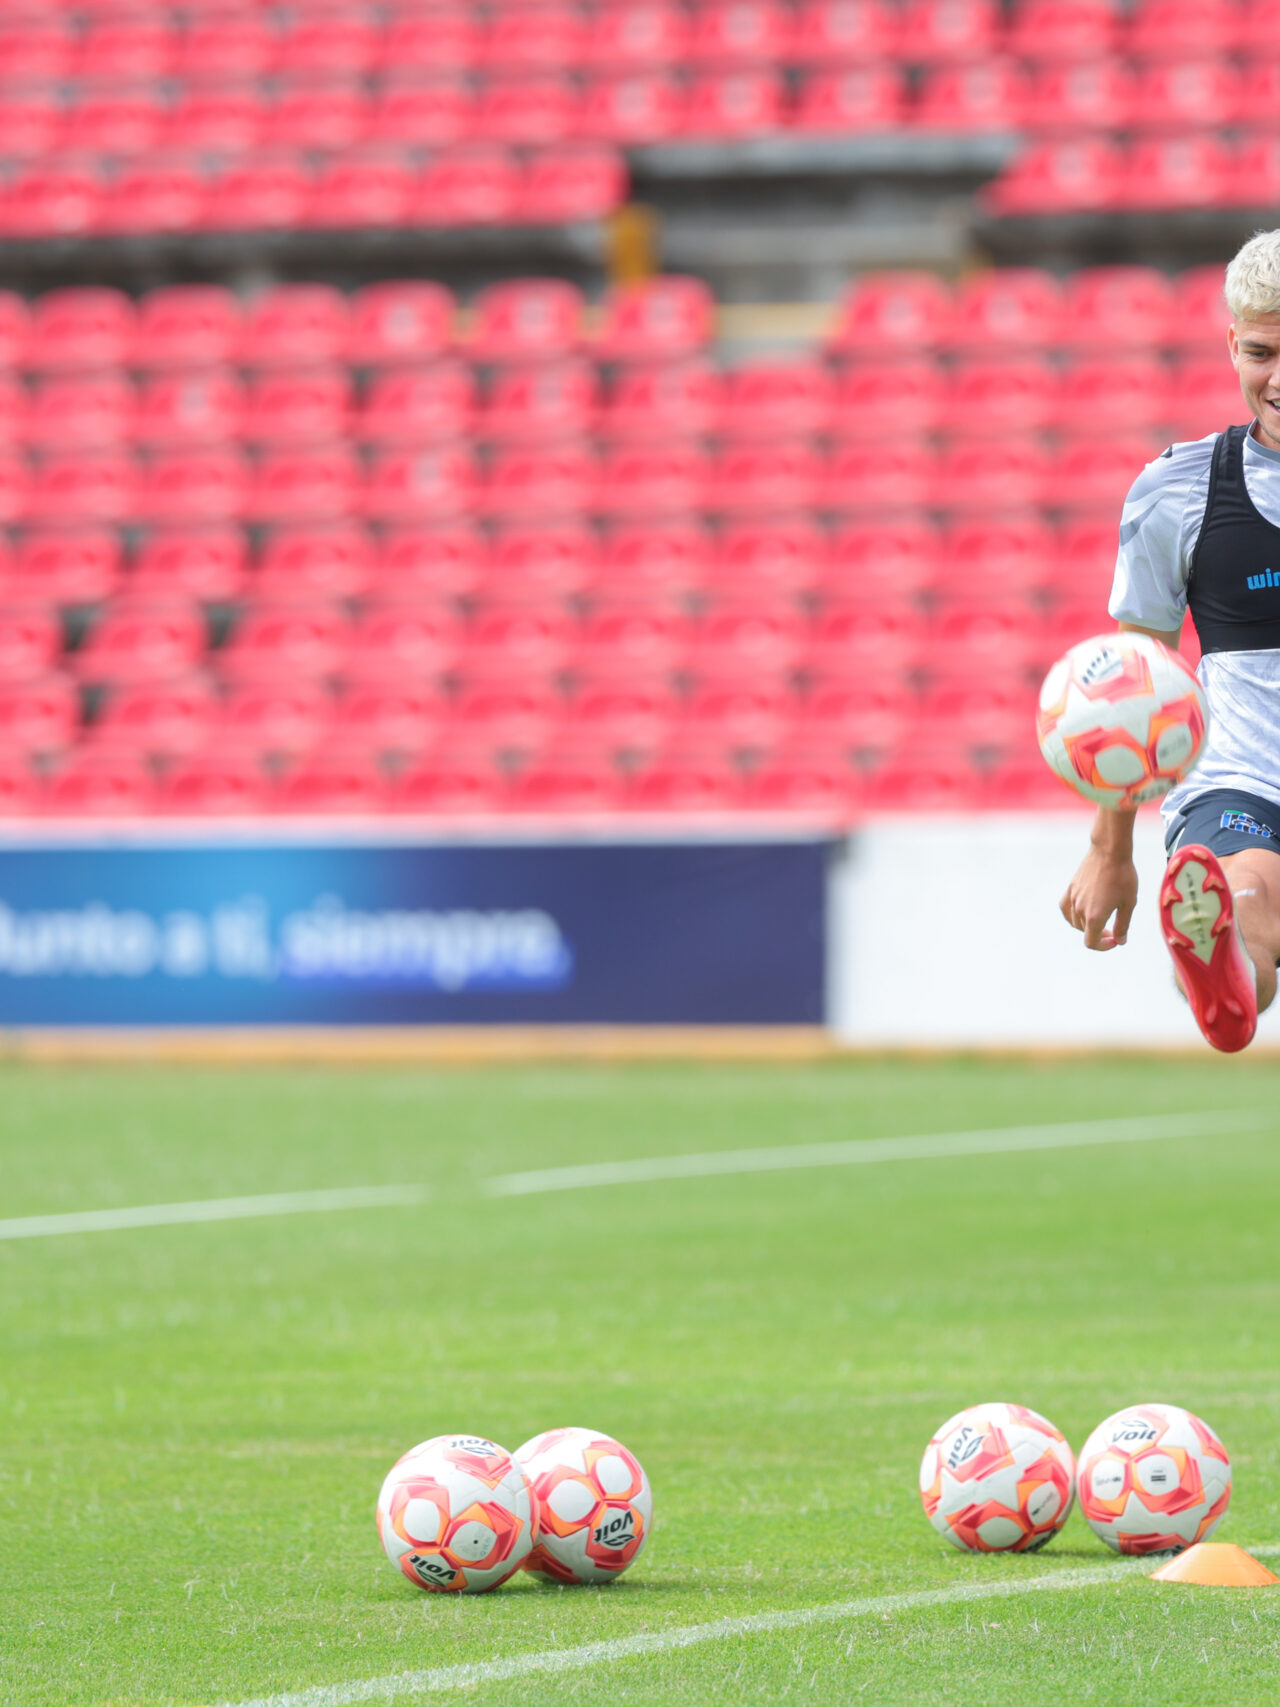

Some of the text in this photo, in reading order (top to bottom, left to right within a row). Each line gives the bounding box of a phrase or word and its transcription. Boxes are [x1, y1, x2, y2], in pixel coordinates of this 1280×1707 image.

[161, 909, 205, 976] a
[594, 1510, 634, 1543] Voit
[409, 1554, 457, 1580] Voit
